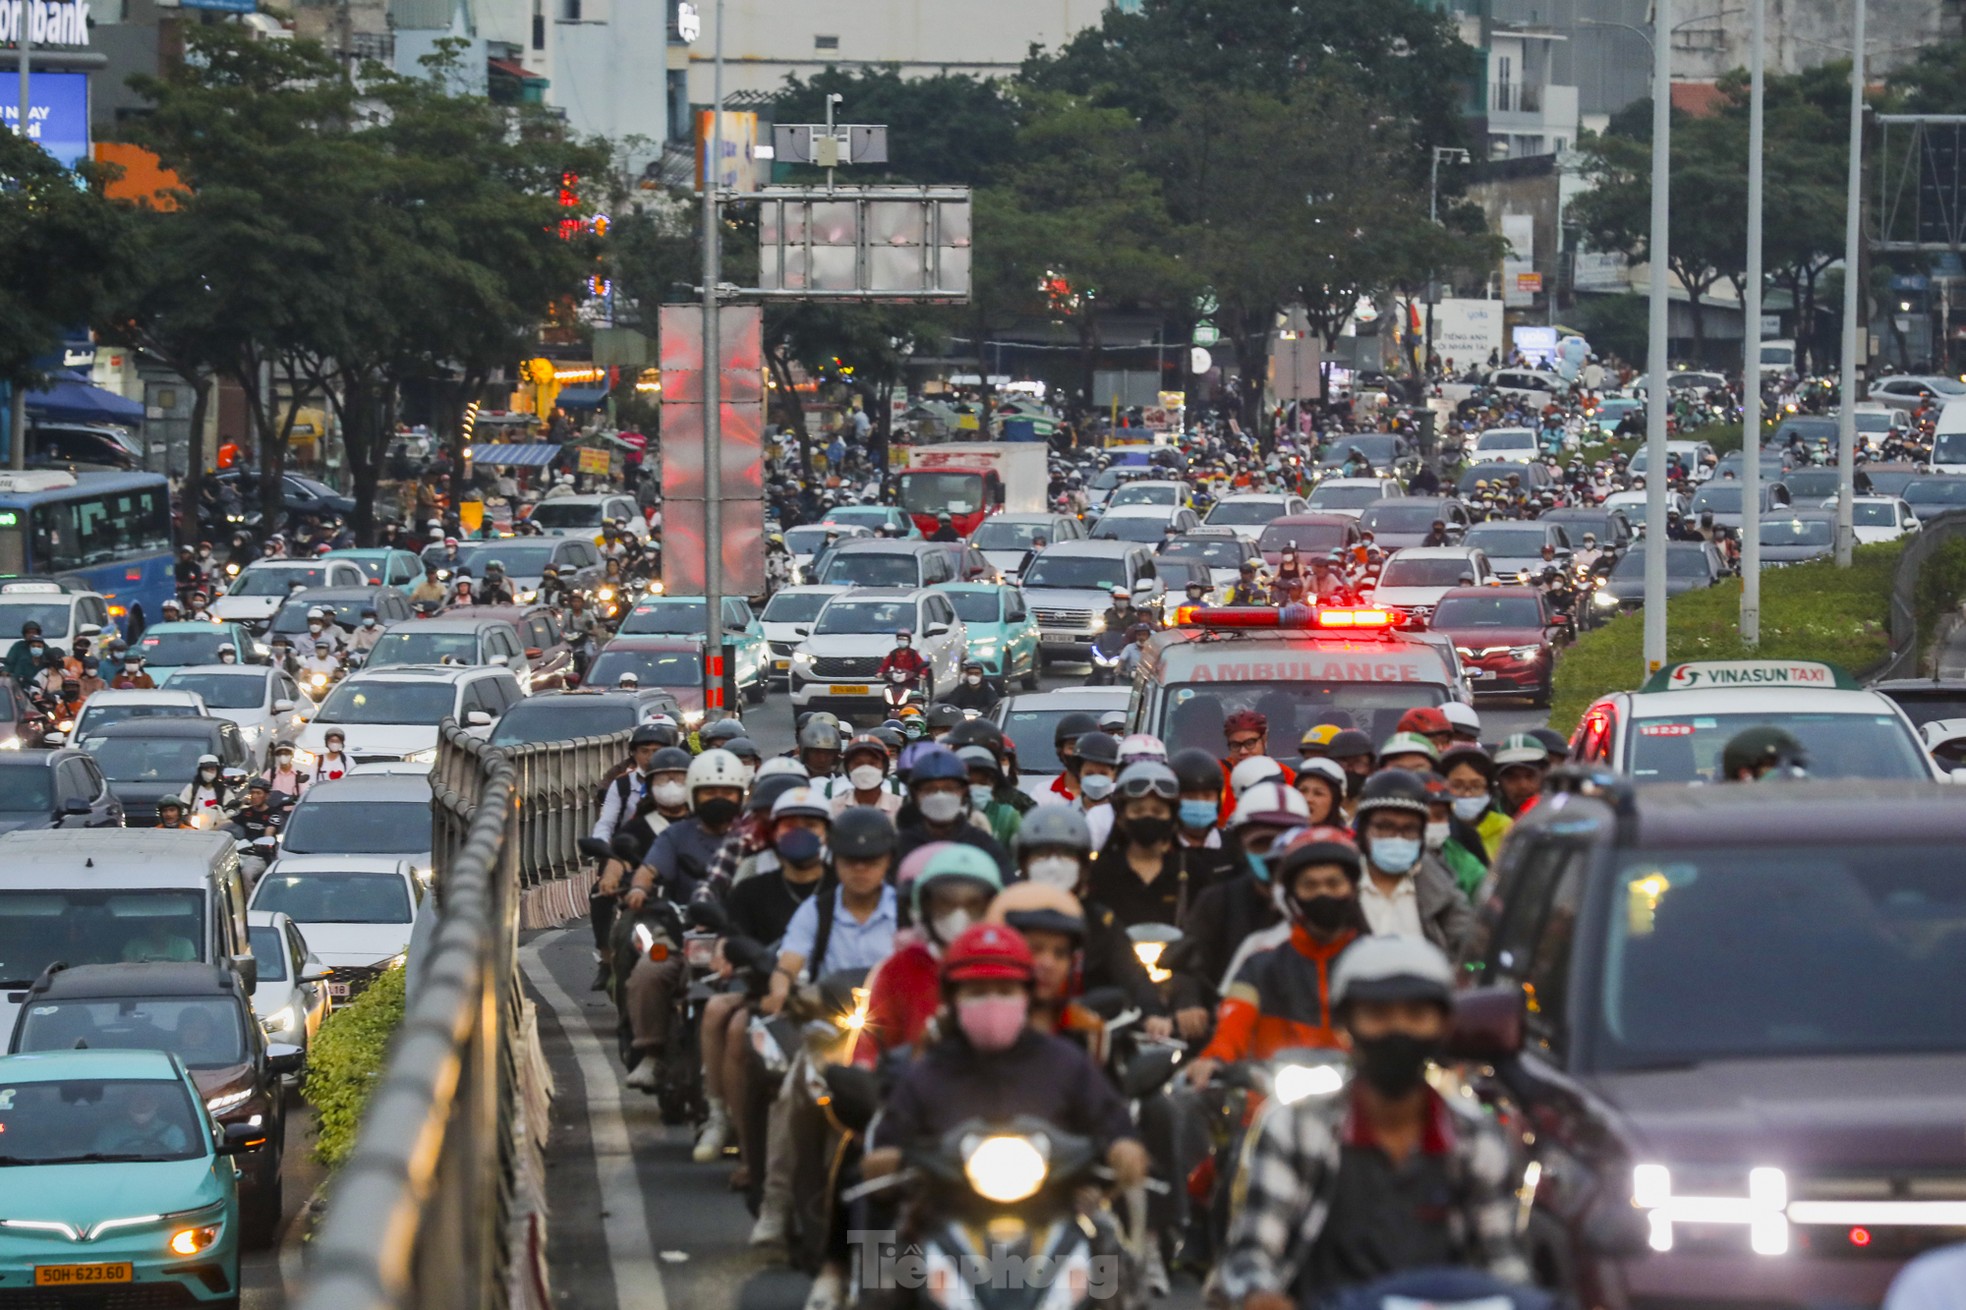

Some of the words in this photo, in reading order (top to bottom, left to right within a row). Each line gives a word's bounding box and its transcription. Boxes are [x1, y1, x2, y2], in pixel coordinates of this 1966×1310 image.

[1189, 662, 1421, 682] AMBULANCE
[1707, 667, 1788, 683] VINASUN
[1790, 667, 1825, 682] TAXI
[43, 1265, 125, 1282] 50H-623.60
